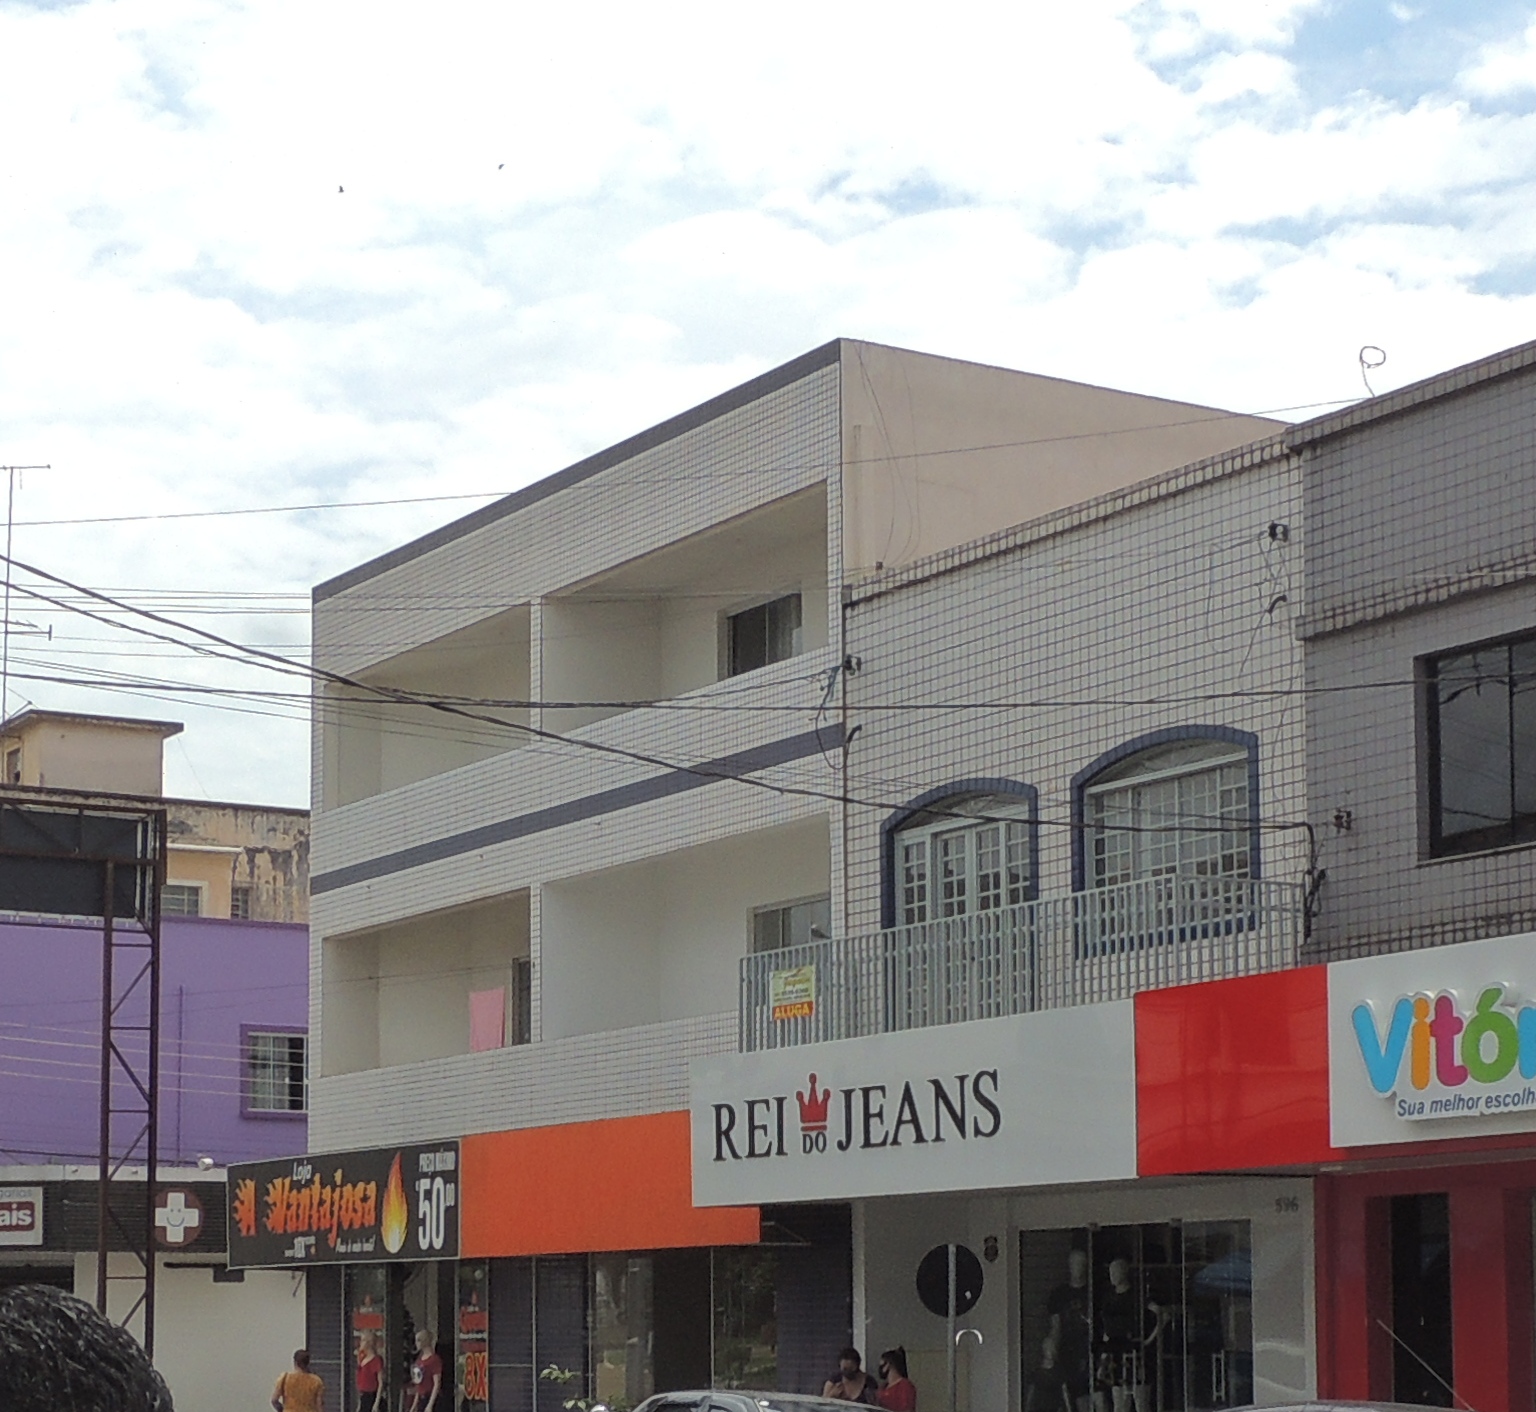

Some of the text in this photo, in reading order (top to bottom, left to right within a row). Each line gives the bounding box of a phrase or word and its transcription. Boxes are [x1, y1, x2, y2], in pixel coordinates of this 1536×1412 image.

[774, 1003, 810, 1019] ALUGA
[710, 1068, 1002, 1162] REI DO JEANS
[1397, 1099, 1426, 1117] Sua
[1428, 1094, 1483, 1115] melhor
[293, 1160, 313, 1184] Loja
